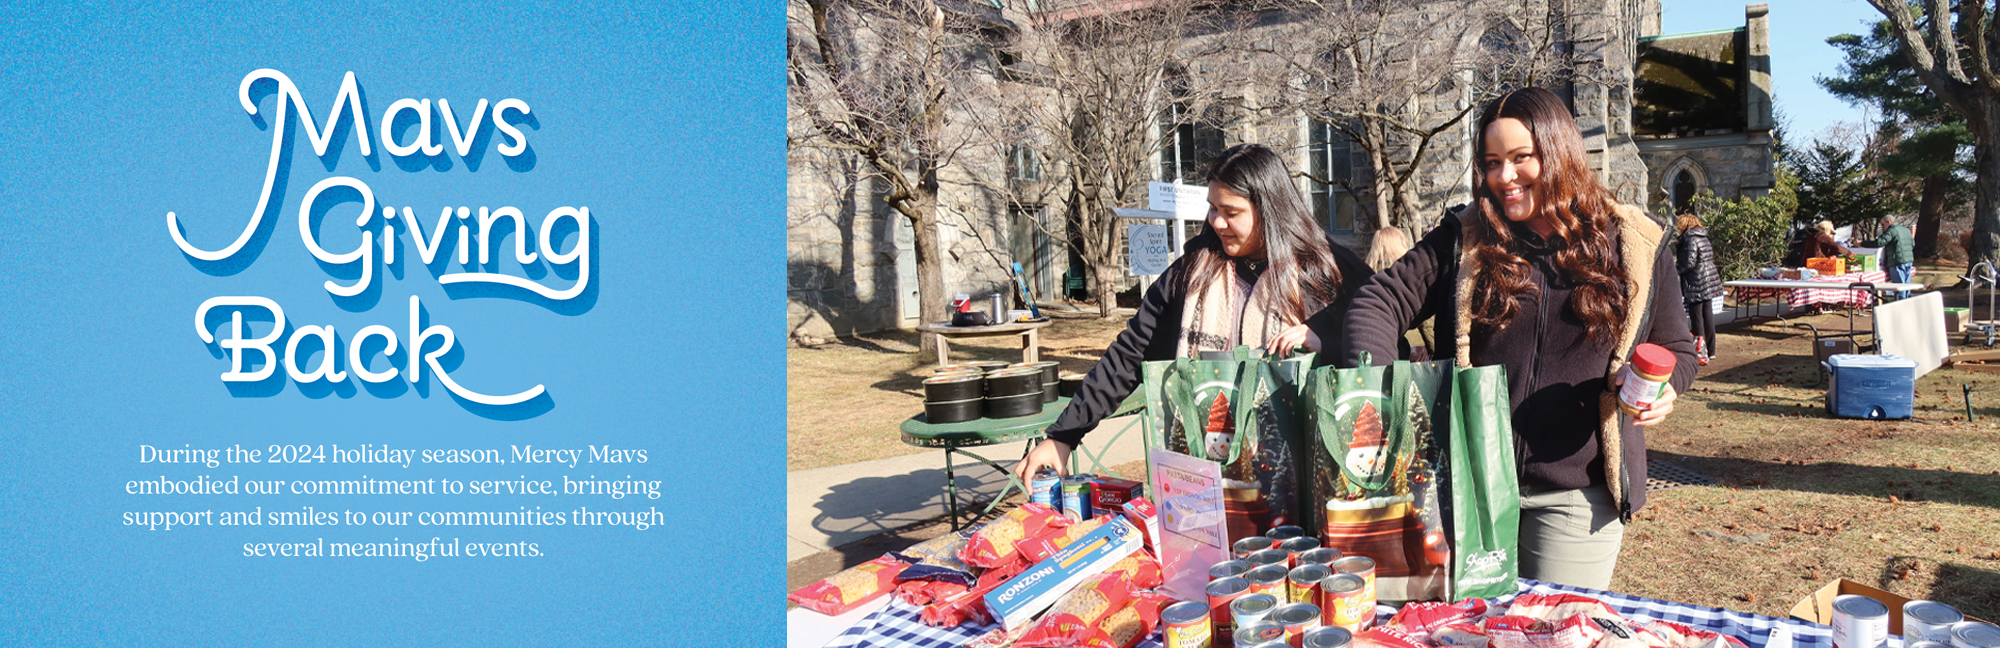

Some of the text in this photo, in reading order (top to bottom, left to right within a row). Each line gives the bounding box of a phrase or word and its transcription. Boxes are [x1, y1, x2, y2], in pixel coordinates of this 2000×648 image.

[1145, 246, 1167, 254] YOGA
[1051, 549, 1067, 560] Thin
[1054, 543, 1086, 563] Spaghetti
[997, 566, 1056, 604] RONZONI
[1375, 625, 1428, 648] HITE RIC
